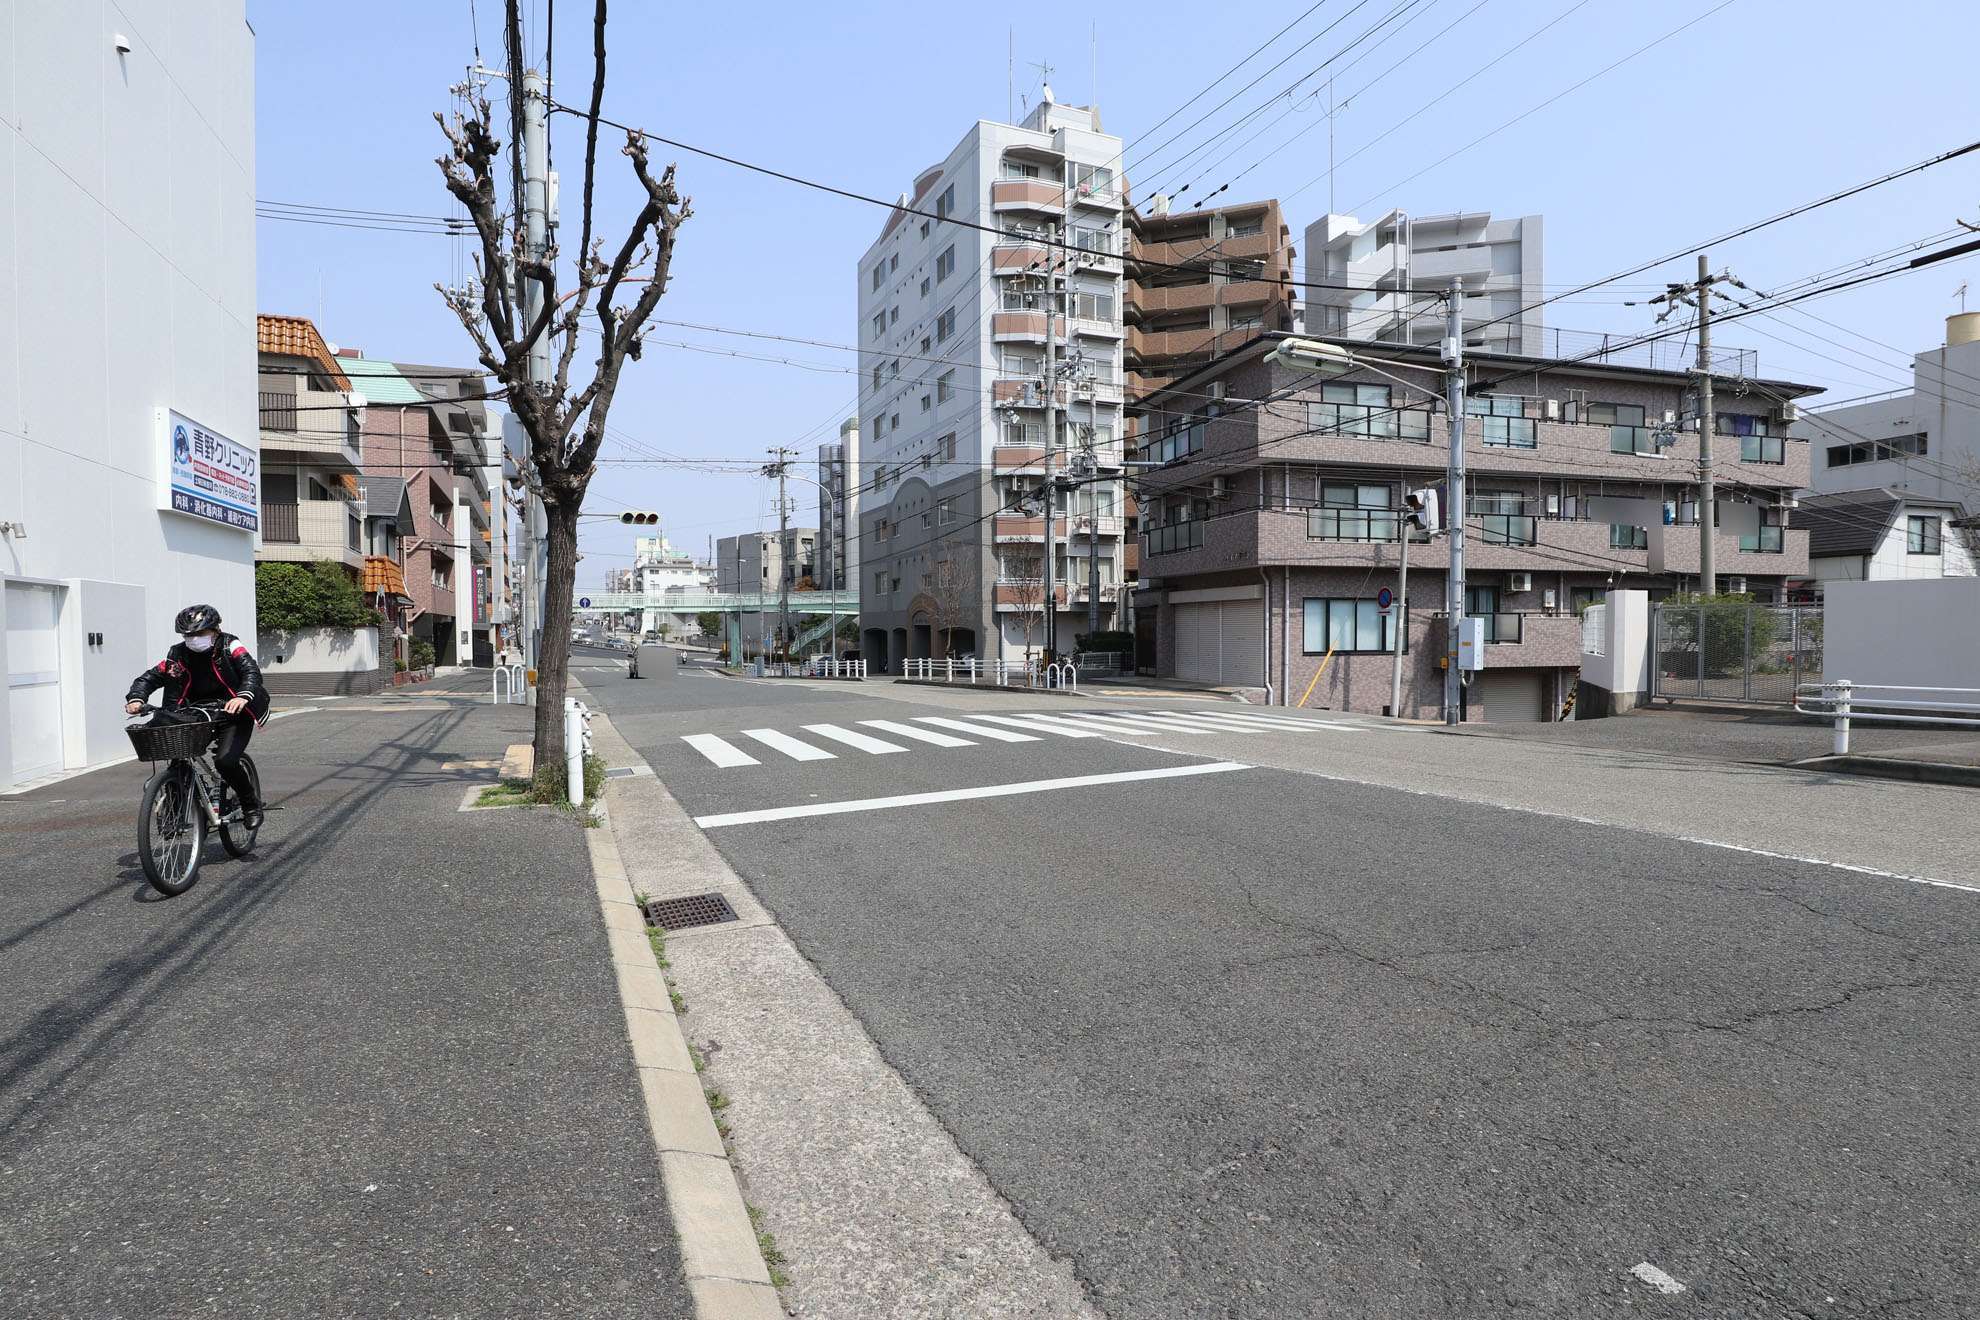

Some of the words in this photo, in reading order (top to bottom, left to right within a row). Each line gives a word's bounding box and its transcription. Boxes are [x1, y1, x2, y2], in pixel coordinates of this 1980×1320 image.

[193, 429, 255, 477] 青野クリニック
